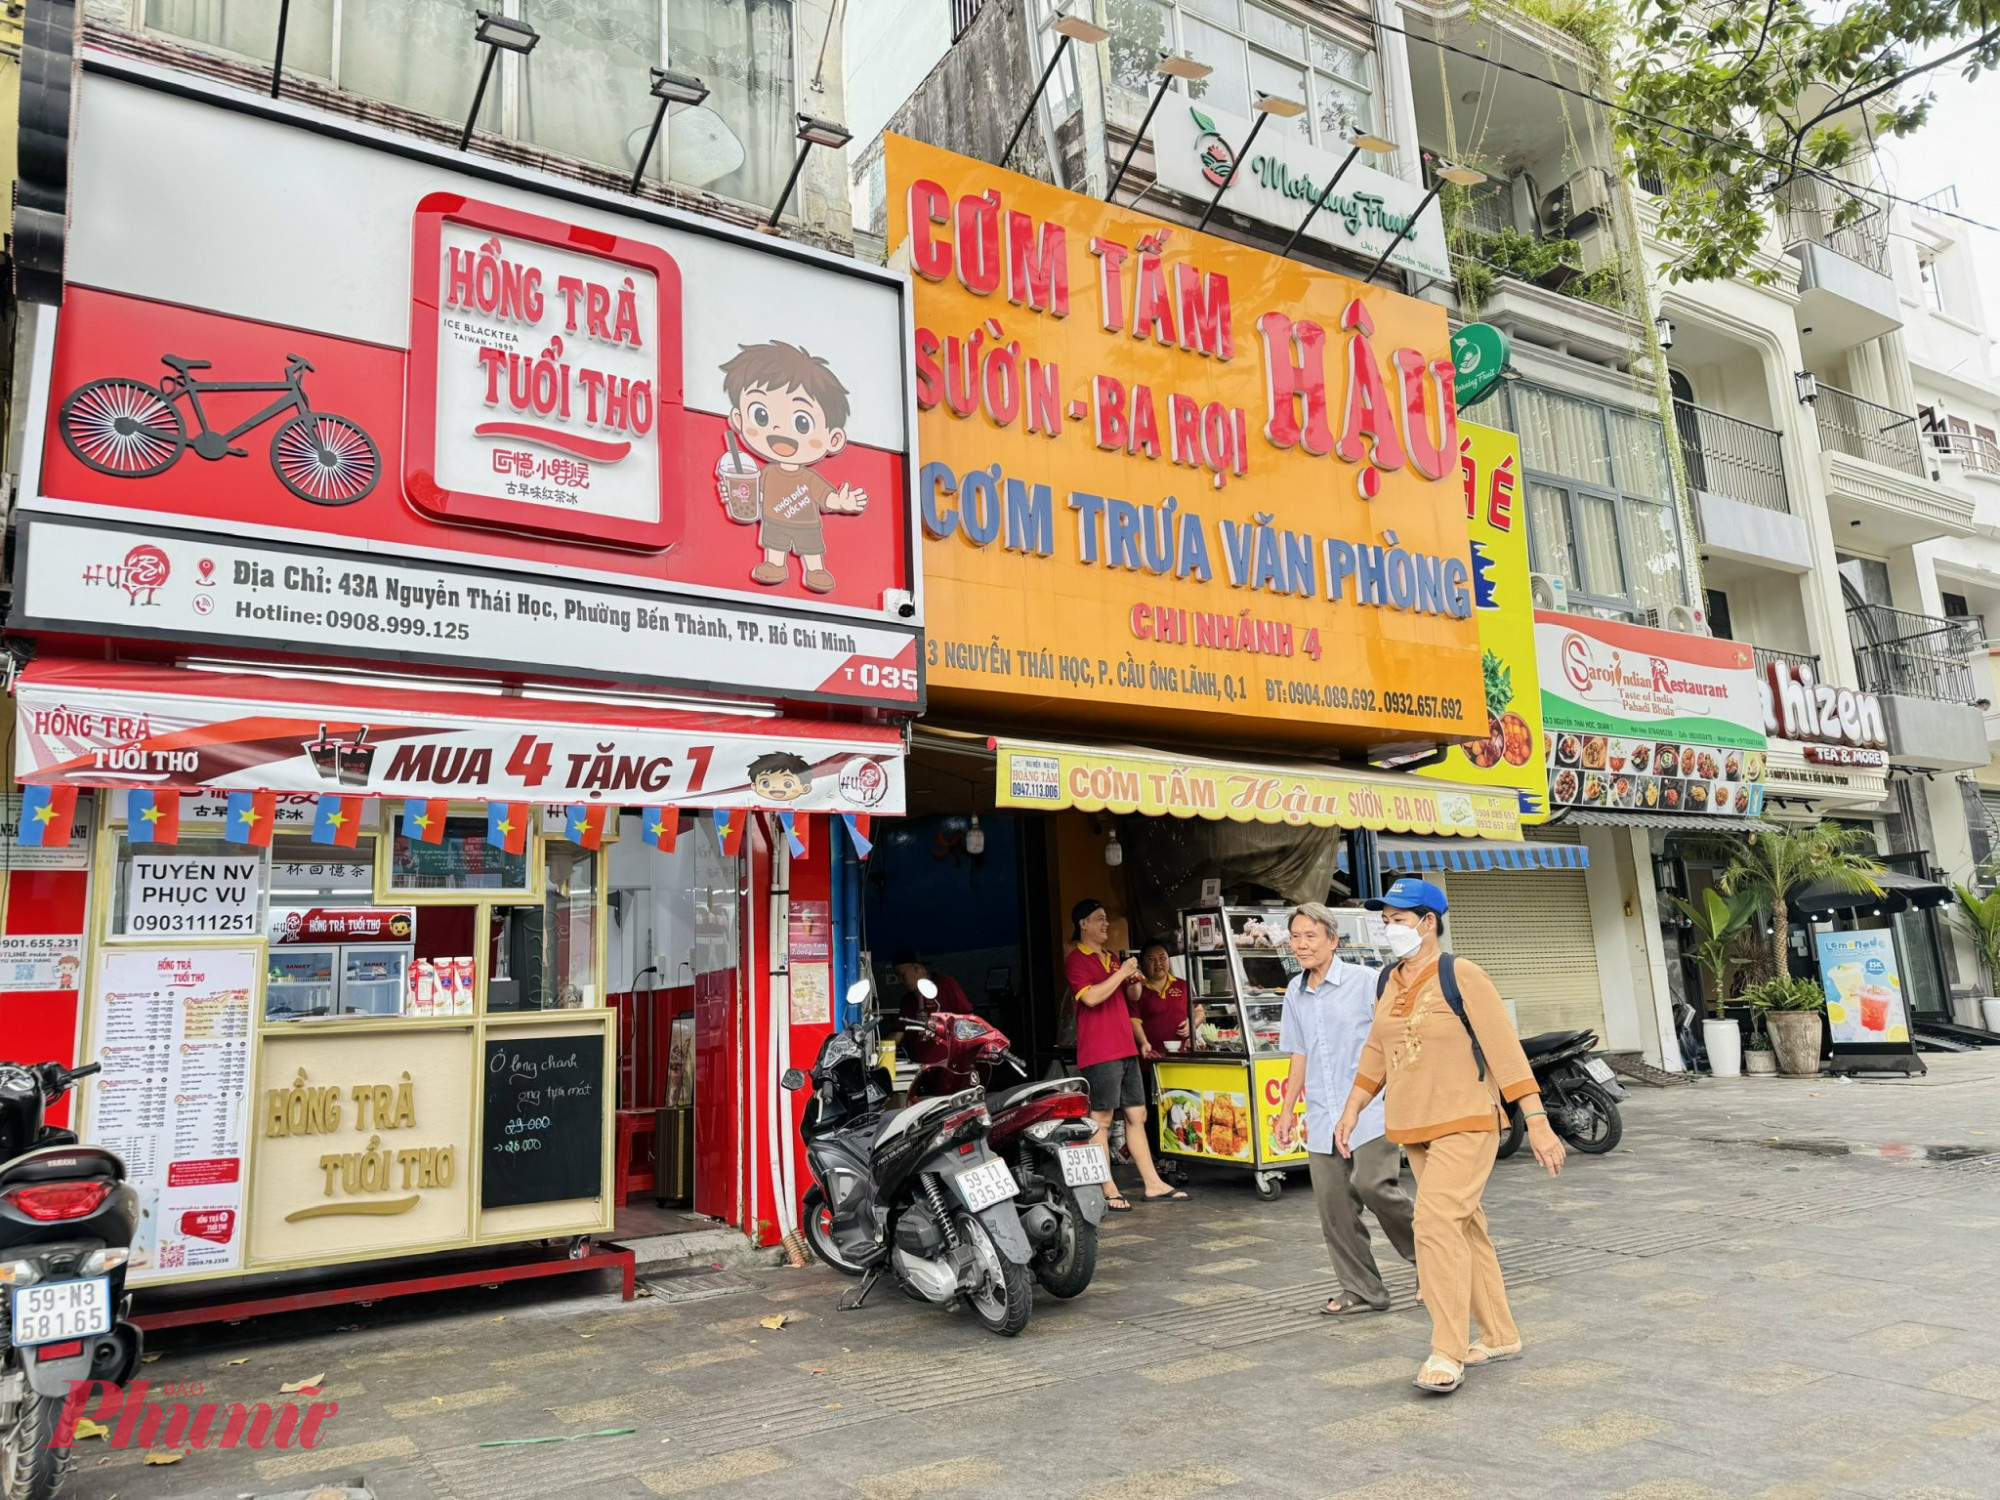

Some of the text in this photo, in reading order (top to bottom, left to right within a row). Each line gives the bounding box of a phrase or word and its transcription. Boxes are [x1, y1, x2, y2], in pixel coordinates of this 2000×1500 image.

[906, 178, 1235, 362] CƠM TẤM
[446, 236, 642, 348] HỒNG TRÀ
[443, 318, 519, 343] ICE BLACKTEA
[454, 332, 514, 352] TAIWAN 1999
[478, 336, 652, 436] TUỔI THƠ
[1257, 298, 1457, 501] HẬU
[1168, 393, 1249, 490] RỌI
[920, 461, 1473, 620] CƠM TRƯA VĂN PHÒNG
[233, 560, 856, 653] Địa Chỉ: 43A Nguyễn Thái Học, Phường Bến Thành, TP. Hồ Chí Minh
[236, 601, 470, 640] Hotline: 0908.999.125
[1130, 601, 1323, 661] CHI NHÁNH 4
[844, 663, 918, 691] T 035
[944, 634, 1011, 675] NGUYỄN
[1017, 647, 1055, 680] THÁI
[1058, 655, 1094, 688] HỌC,
[1098, 660, 1112, 686] P.
[1117, 651, 1146, 689] CẦU
[1149, 656, 1179, 690] ÔNG
[1181, 660, 1221, 702] LÃNH,
[1617, 688, 1641, 700] Taste
[1653, 693, 1674, 704] India
[32, 704, 152, 740] HỒNG TRÀ
[91, 743, 199, 773] TUỔI THƠ
[383, 734, 714, 799] MUA 4 TẶNG 1
[1817, 747, 1881, 764] TEA & MORE
[1012, 768, 1039, 781] HOÀNG
[1012, 782, 1058, 798] 0947.113.006
[1069, 764, 1437, 827] CƠM TẤM Hậu SƯỜN BA RỌI
[137, 860, 255, 880] TUYỂN NV
[142, 887, 247, 907] PHỤC VỤ
[134, 914, 254, 930] 0903111251
[309, 915, 381, 932] HỒNG TRÀ TUỔI THƠ
[0, 938, 78, 948] 901.655.231
[1825, 937, 1886, 951] Lemonade
[176, 958, 191, 970] TRÀ
[541, 1053, 578, 1071] chanh
[266, 1067, 341, 1137] HỒNG
[352, 1071, 416, 1131] TRÀ
[319, 1135, 455, 1196] TUỔI THƠ
[965, 1164, 1002, 1189] 59-T1
[1066, 1164, 1106, 1184] 548.31
[969, 1178, 1015, 1208] 935.55
[29, 1283, 95, 1313] 59-N3
[21, 1307, 102, 1340] 581.65
